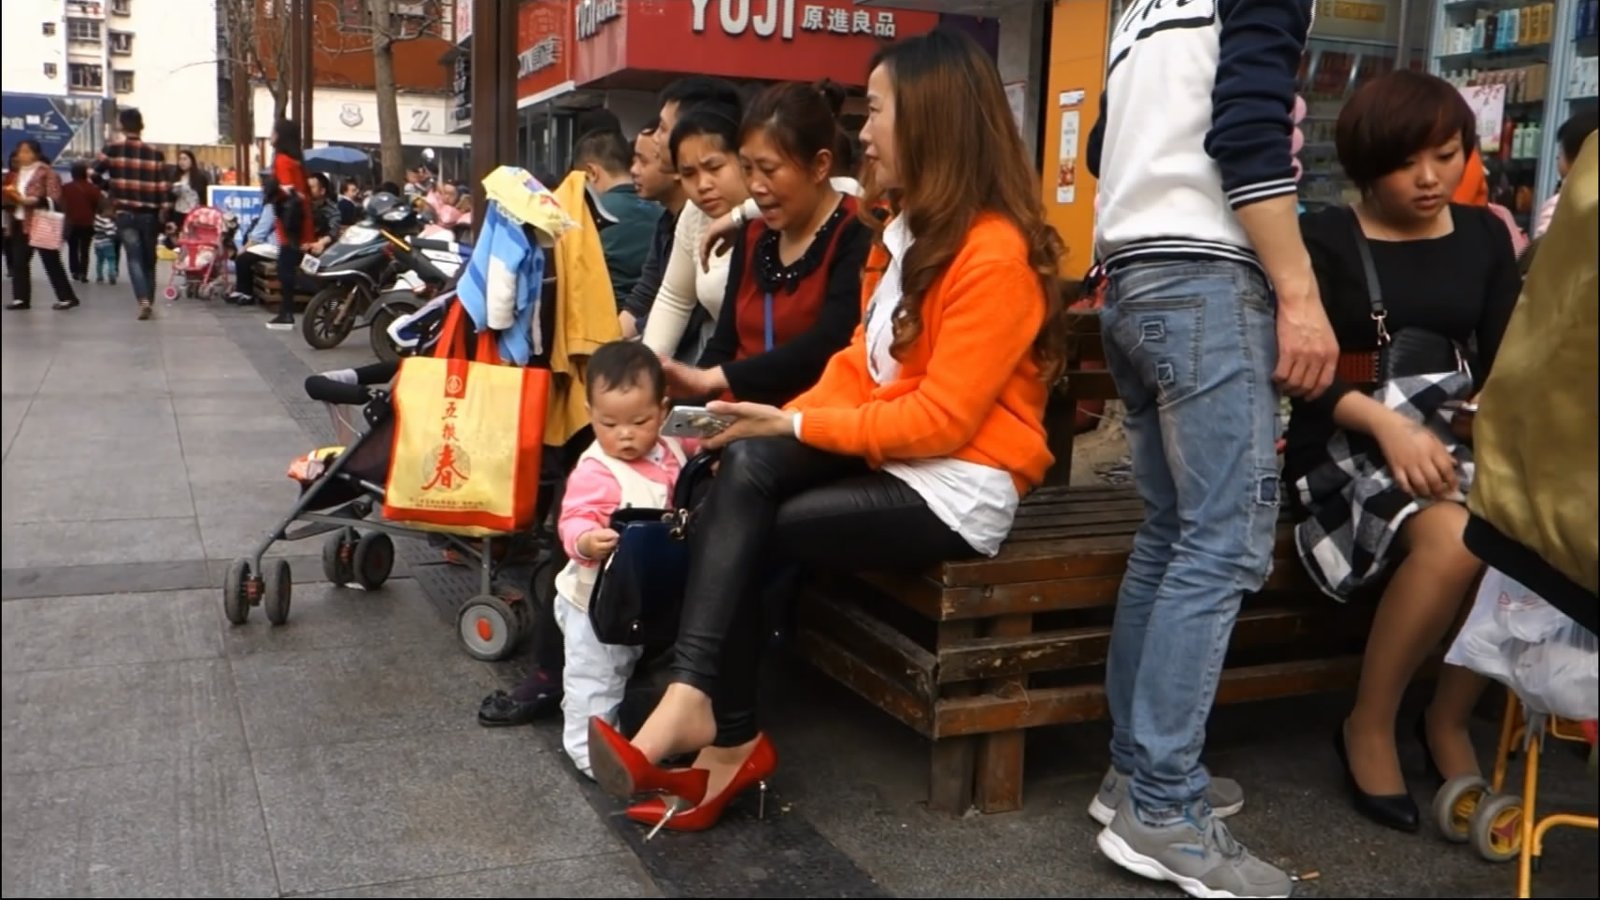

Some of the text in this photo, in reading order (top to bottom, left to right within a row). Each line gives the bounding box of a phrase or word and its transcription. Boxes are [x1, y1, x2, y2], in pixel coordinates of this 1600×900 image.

[690, 0, 794, 39] YUJI
[801, 4, 897, 38] 原進良品
[411, 109, 431, 132] Z
